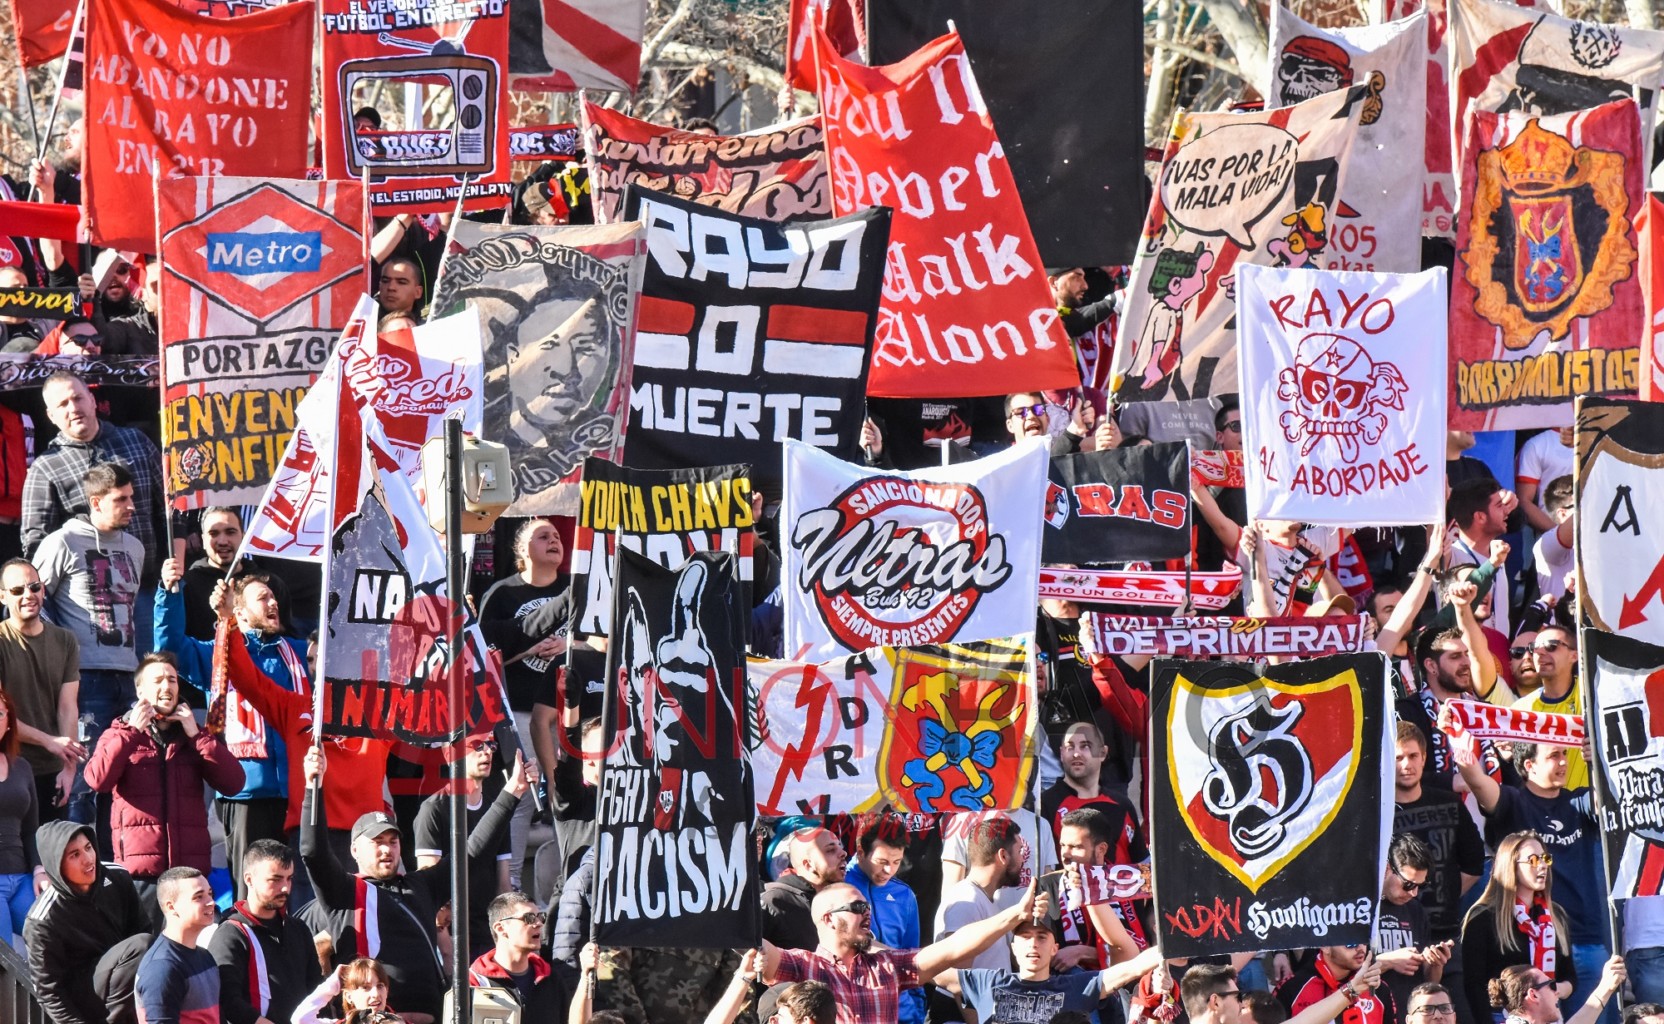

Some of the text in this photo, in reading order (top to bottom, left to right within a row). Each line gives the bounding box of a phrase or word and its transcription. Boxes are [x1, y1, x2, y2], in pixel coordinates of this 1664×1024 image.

[350, 1, 367, 15] EL
[395, 9, 421, 28] EN
[122, 20, 231, 67] YO NO
[91, 53, 289, 110] ABANDONE
[97, 95, 258, 148] AL RAYO
[115, 139, 159, 175] EN
[1217, 148, 1264, 180] POR
[1267, 139, 1292, 169] LA
[480, 184, 496, 196] LA
[1174, 182, 1237, 212] MALA
[212, 240, 312, 268] Metro
[638, 197, 868, 291] RAYO
[1269, 288, 1396, 335] RAYO
[695, 304, 761, 377] O
[872, 306, 1060, 368] Alone
[630, 382, 843, 448] MUERTE
[1161, 421, 1211, 431] COME BACK
[1171, 412, 1199, 421] NEVER
[1259, 445, 1279, 483] AL
[1290, 442, 1429, 498] ABORDAJE
[579, 477, 754, 533] YOUTH CHAVS
[847, 481, 985, 540] SANCIONADOS
[791, 506, 1014, 595] Ultras
[1039, 585, 1076, 596] OMO
[1082, 587, 1105, 598] UN
[1112, 588, 1148, 600] GOL
[1154, 590, 1171, 601] EN
[830, 593, 970, 648] SIEMPRE PRESENTES
[1104, 630, 1159, 655] DE
[1601, 804, 1618, 833] la
[594, 822, 748, 924] RACISM
[1246, 895, 1372, 938] Hooligans
